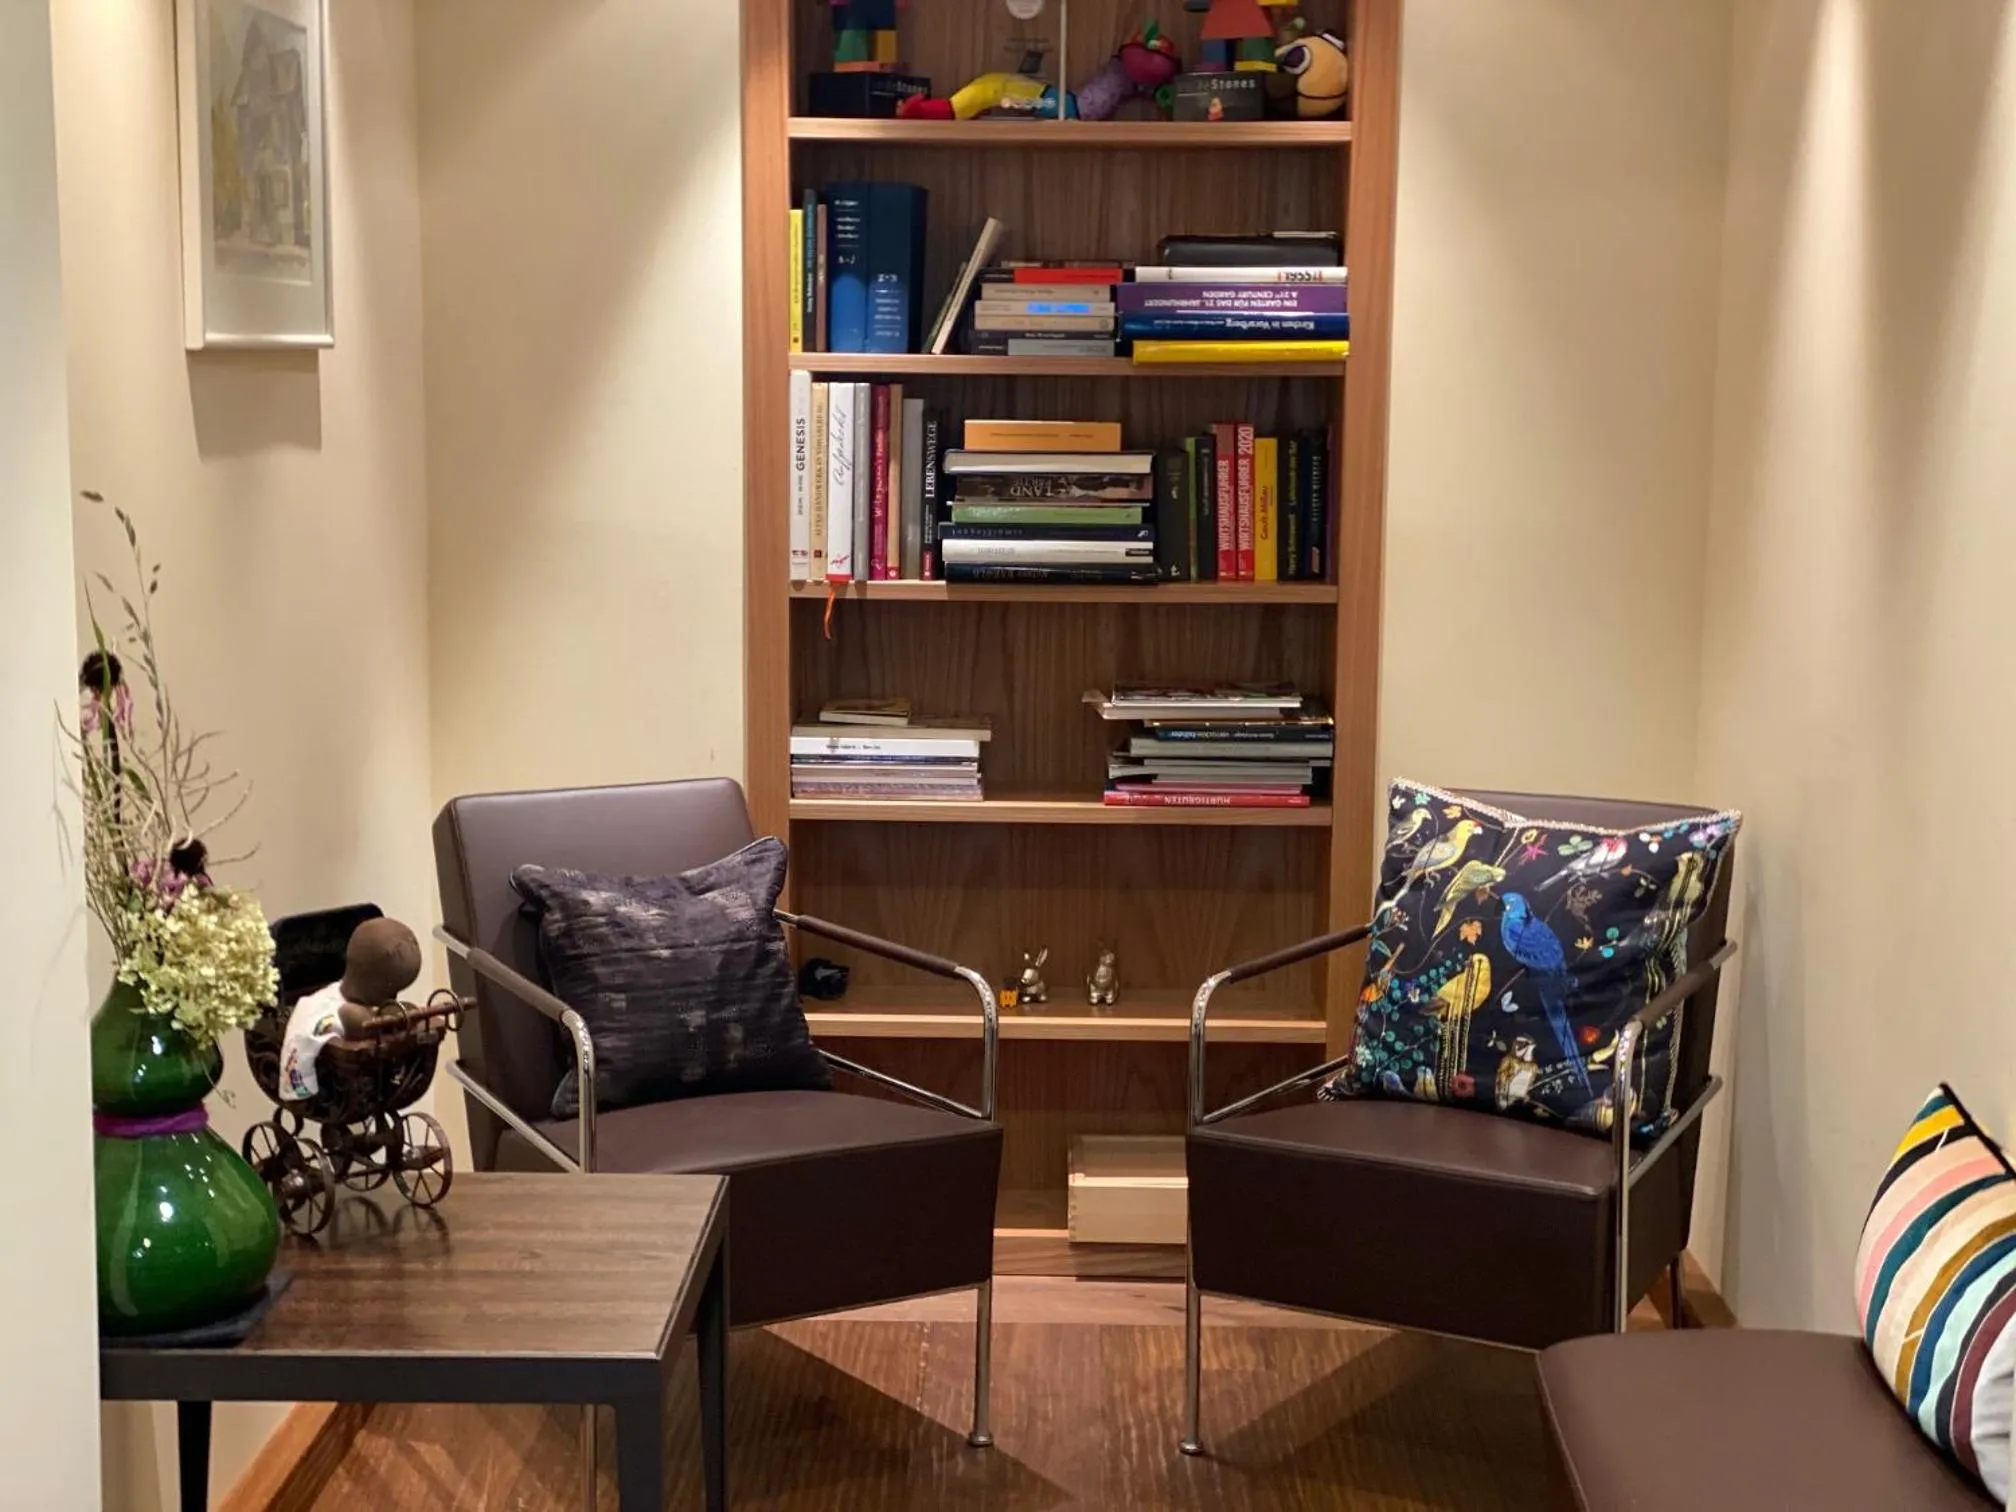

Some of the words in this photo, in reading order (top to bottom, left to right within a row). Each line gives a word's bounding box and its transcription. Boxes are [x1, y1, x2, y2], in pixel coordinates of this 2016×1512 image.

[795, 418, 806, 472] GENESIS
[925, 420, 938, 498] LEBENSWEGE
[1238, 426, 1253, 455] 2020
[1163, 795, 1231, 804] HURTIGRUTEN
